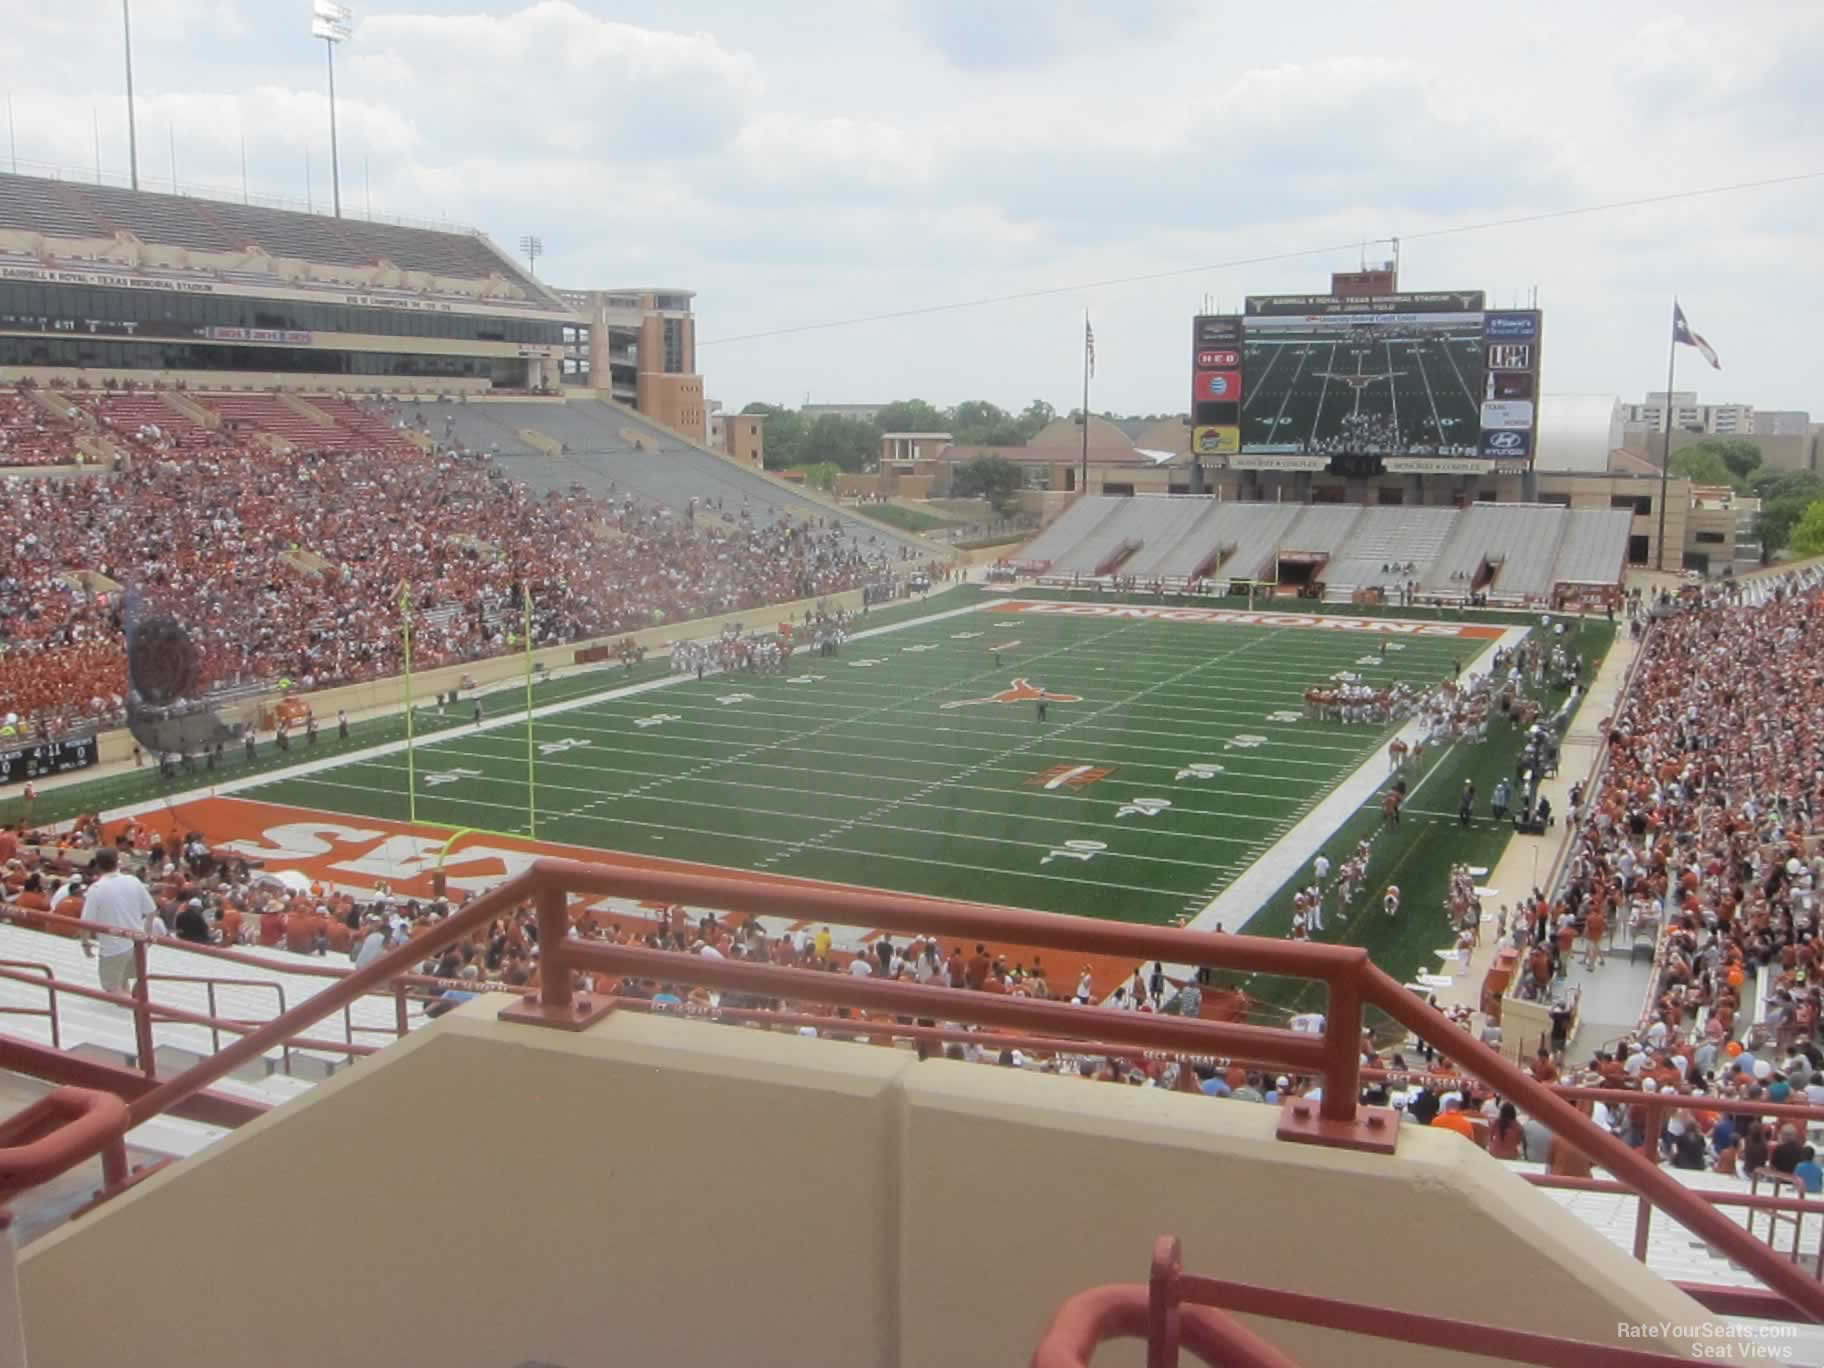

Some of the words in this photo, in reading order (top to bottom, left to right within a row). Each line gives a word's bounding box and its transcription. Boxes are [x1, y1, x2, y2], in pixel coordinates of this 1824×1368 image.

[1021, 604, 1463, 636] LONGHORNS
[77, 746, 86, 759] 0
[1174, 762, 1226, 781] 30
[1115, 797, 1173, 819] 20
[1041, 838, 1109, 865] 10
